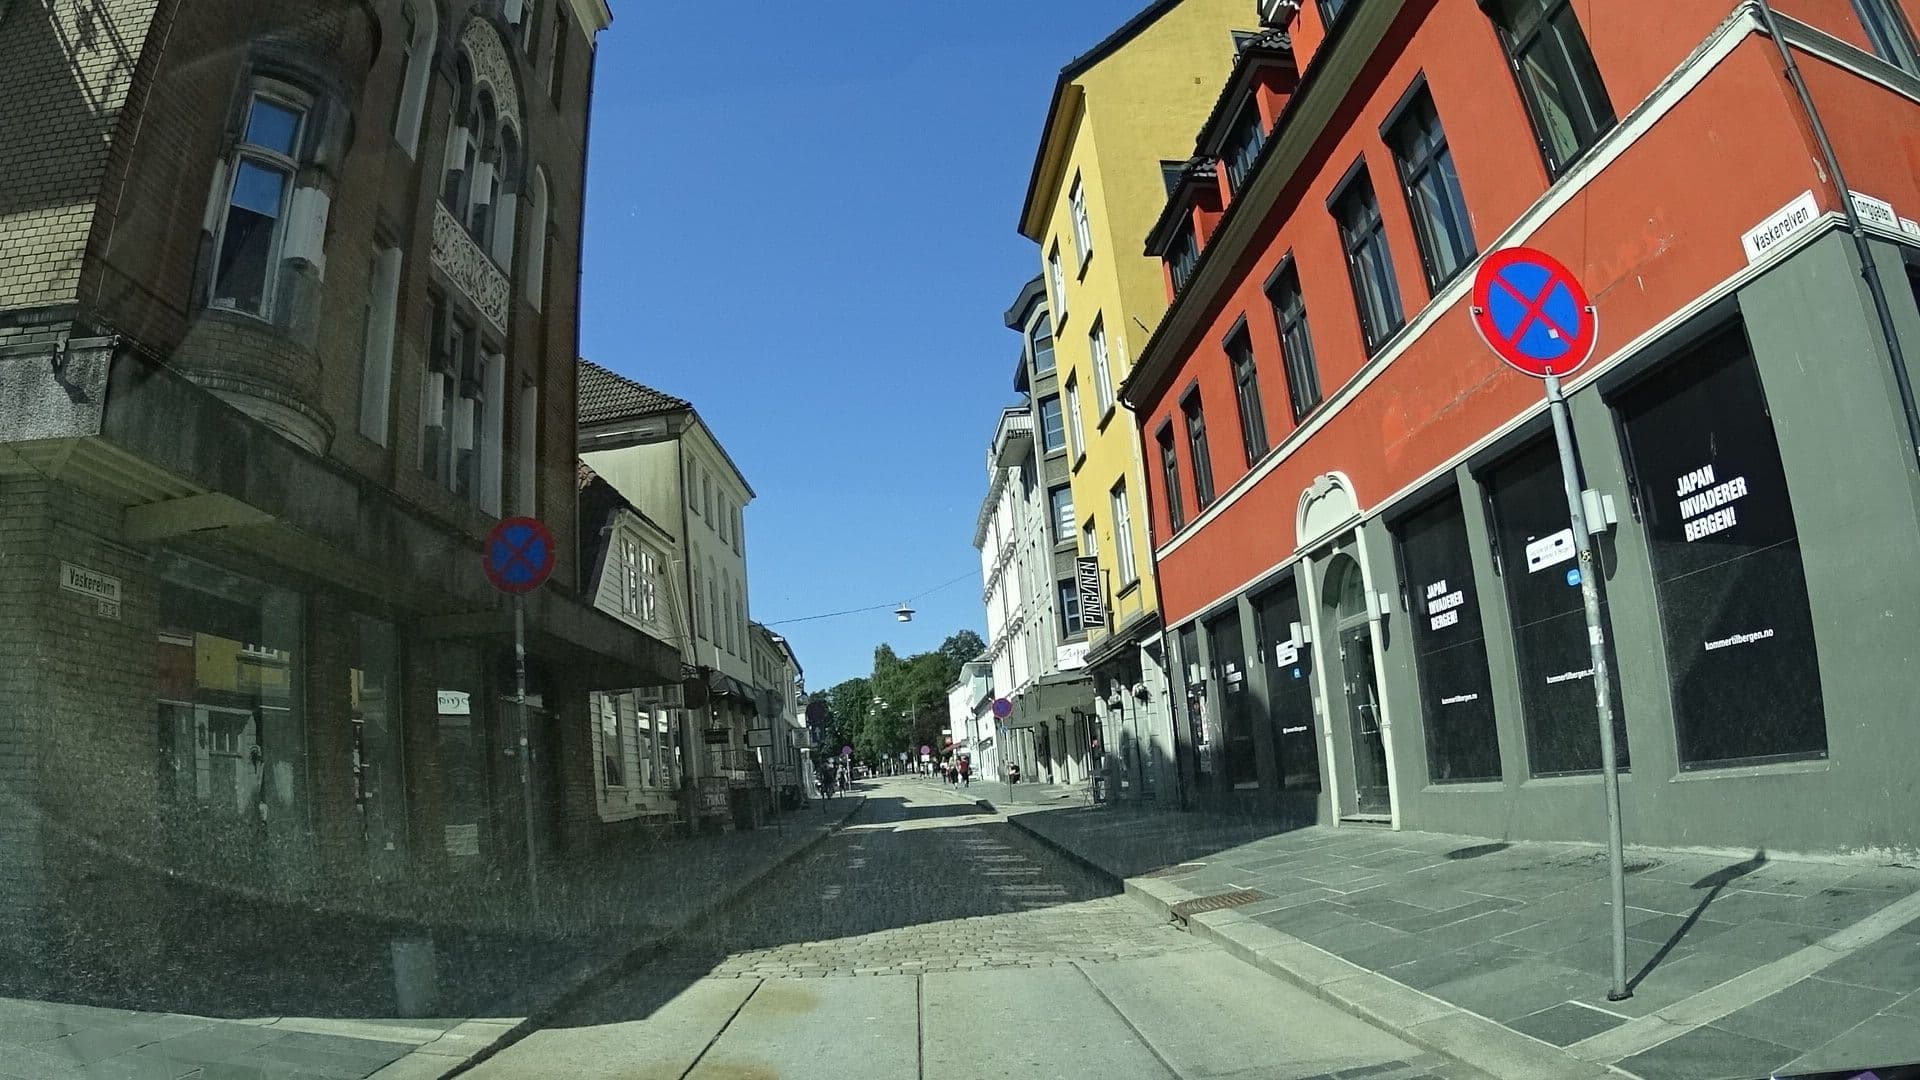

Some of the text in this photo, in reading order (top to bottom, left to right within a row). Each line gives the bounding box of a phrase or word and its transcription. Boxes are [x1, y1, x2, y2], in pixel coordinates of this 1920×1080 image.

[1752, 206, 1809, 252] Vaskerelven
[1676, 464, 1715, 497] JAPAN
[1679, 476, 1748, 520] INVADERER
[1684, 506, 1737, 543] BERGEN!
[1080, 561, 1104, 624] PINGVINEN
[1427, 580, 1447, 600] JAPAN
[1704, 628, 1774, 651] kommertilbergen.no
